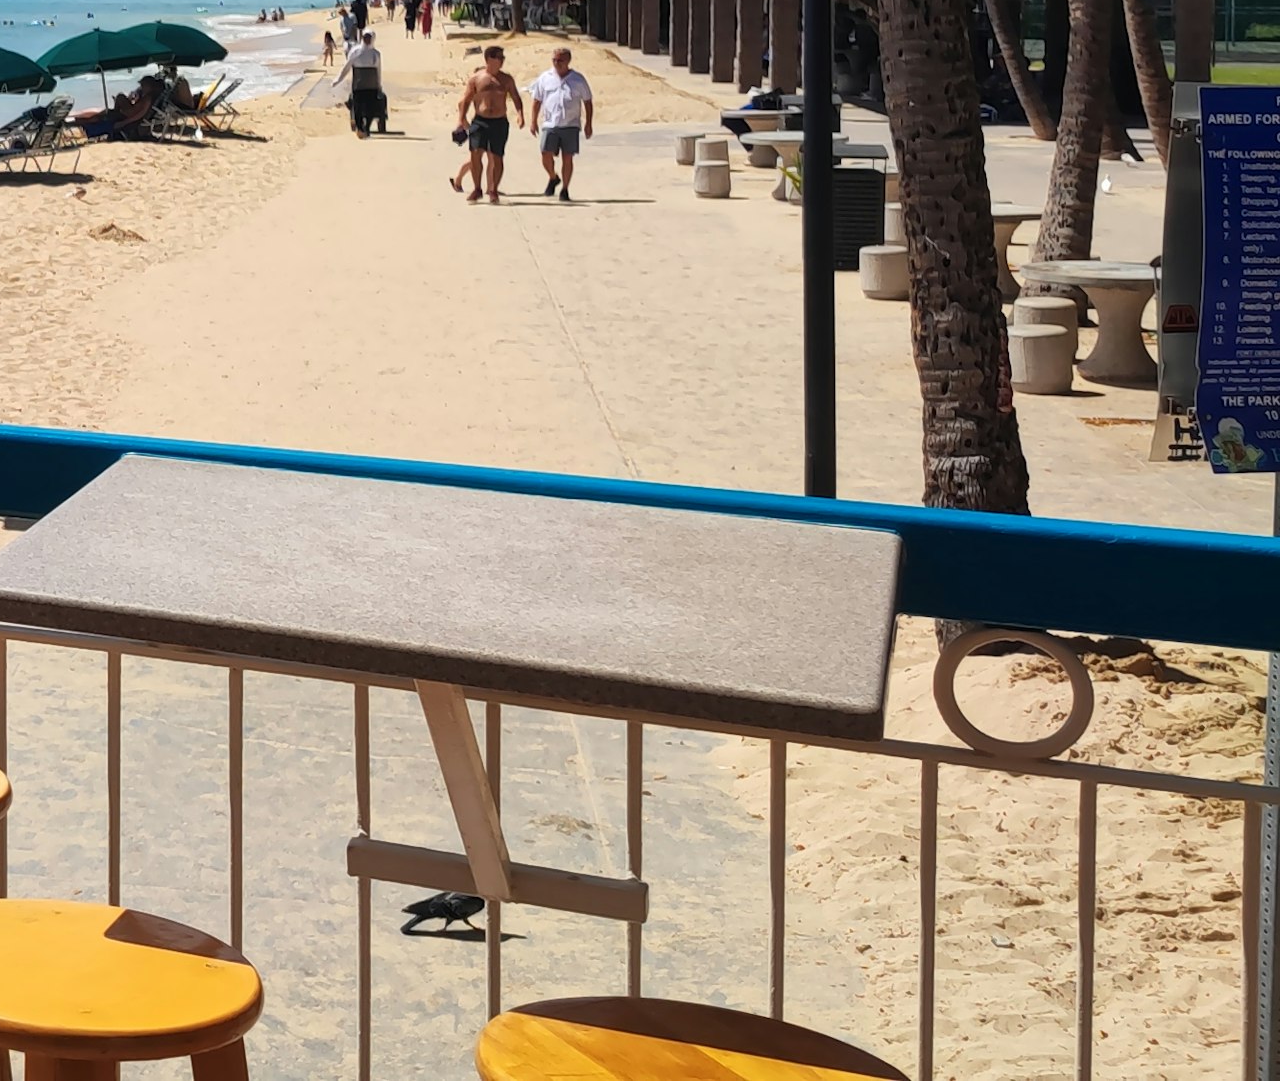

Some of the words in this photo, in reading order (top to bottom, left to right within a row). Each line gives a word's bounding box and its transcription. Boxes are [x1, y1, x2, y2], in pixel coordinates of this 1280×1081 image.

[1207, 113, 1252, 125] ARMED
[1207, 149, 1226, 158] THE
[1227, 149, 1280, 159] FOLLOWING
[1222, 396, 1245, 407] THE
[1248, 396, 1280, 407] PARK
[1265, 410, 1279, 421] 10
